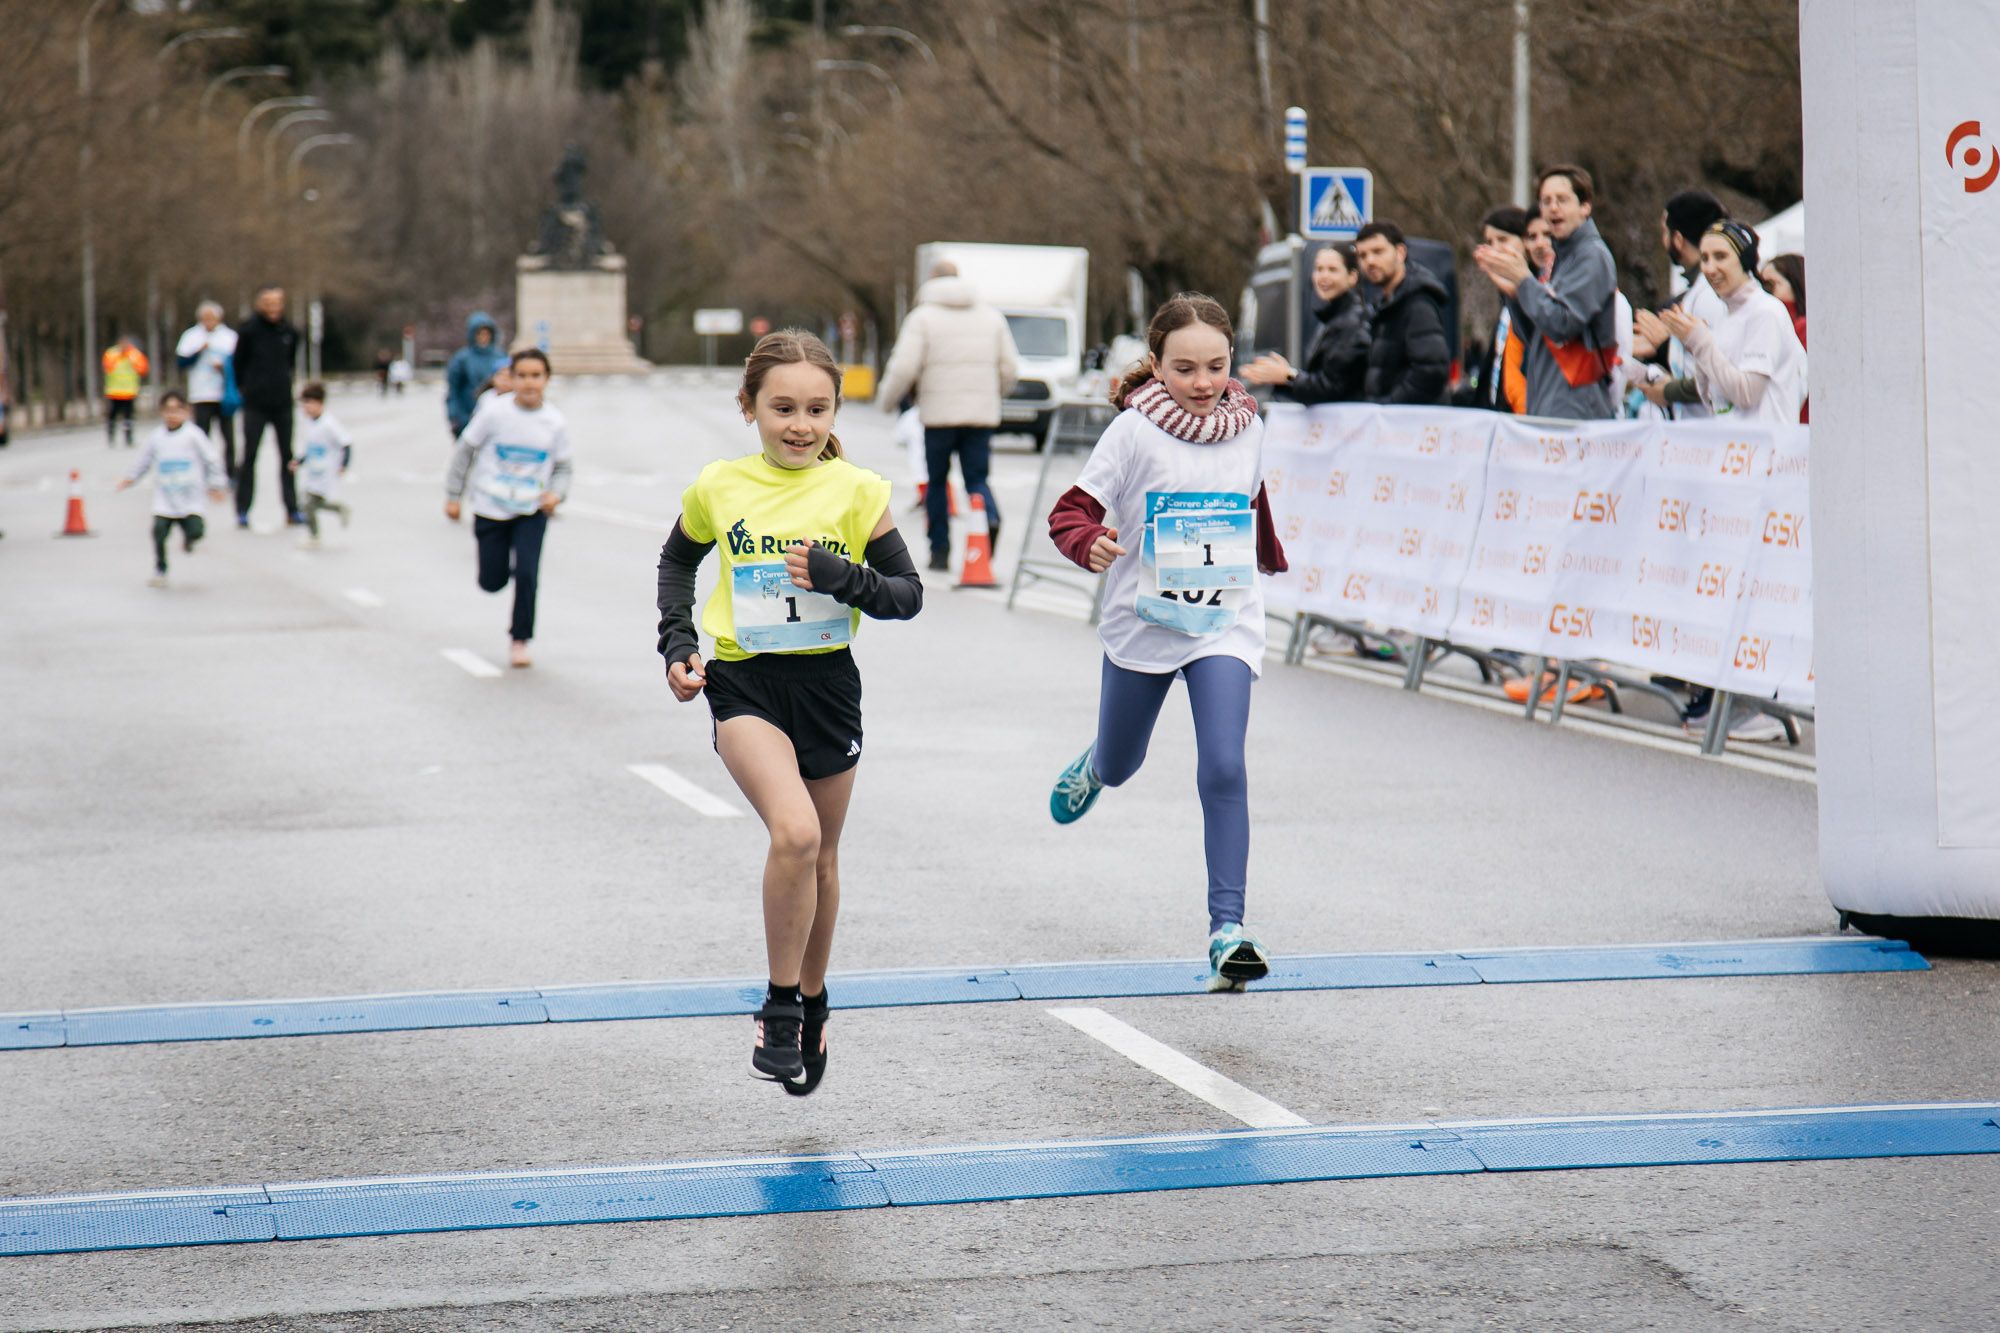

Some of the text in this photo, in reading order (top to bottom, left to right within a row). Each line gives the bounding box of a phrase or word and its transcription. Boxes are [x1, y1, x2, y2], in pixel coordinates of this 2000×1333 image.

[1721, 441, 1757, 476] GSK
[1573, 490, 1621, 524] GSK
[1658, 497, 1690, 533] GSK
[1762, 510, 1804, 549] GSK
[1203, 544, 1214, 566] 1
[1696, 561, 1732, 599] GSK
[785, 596, 801, 623] 1
[1548, 603, 1597, 638] GSK
[1632, 613, 1662, 651] GSK
[1733, 634, 1771, 672] GSK
